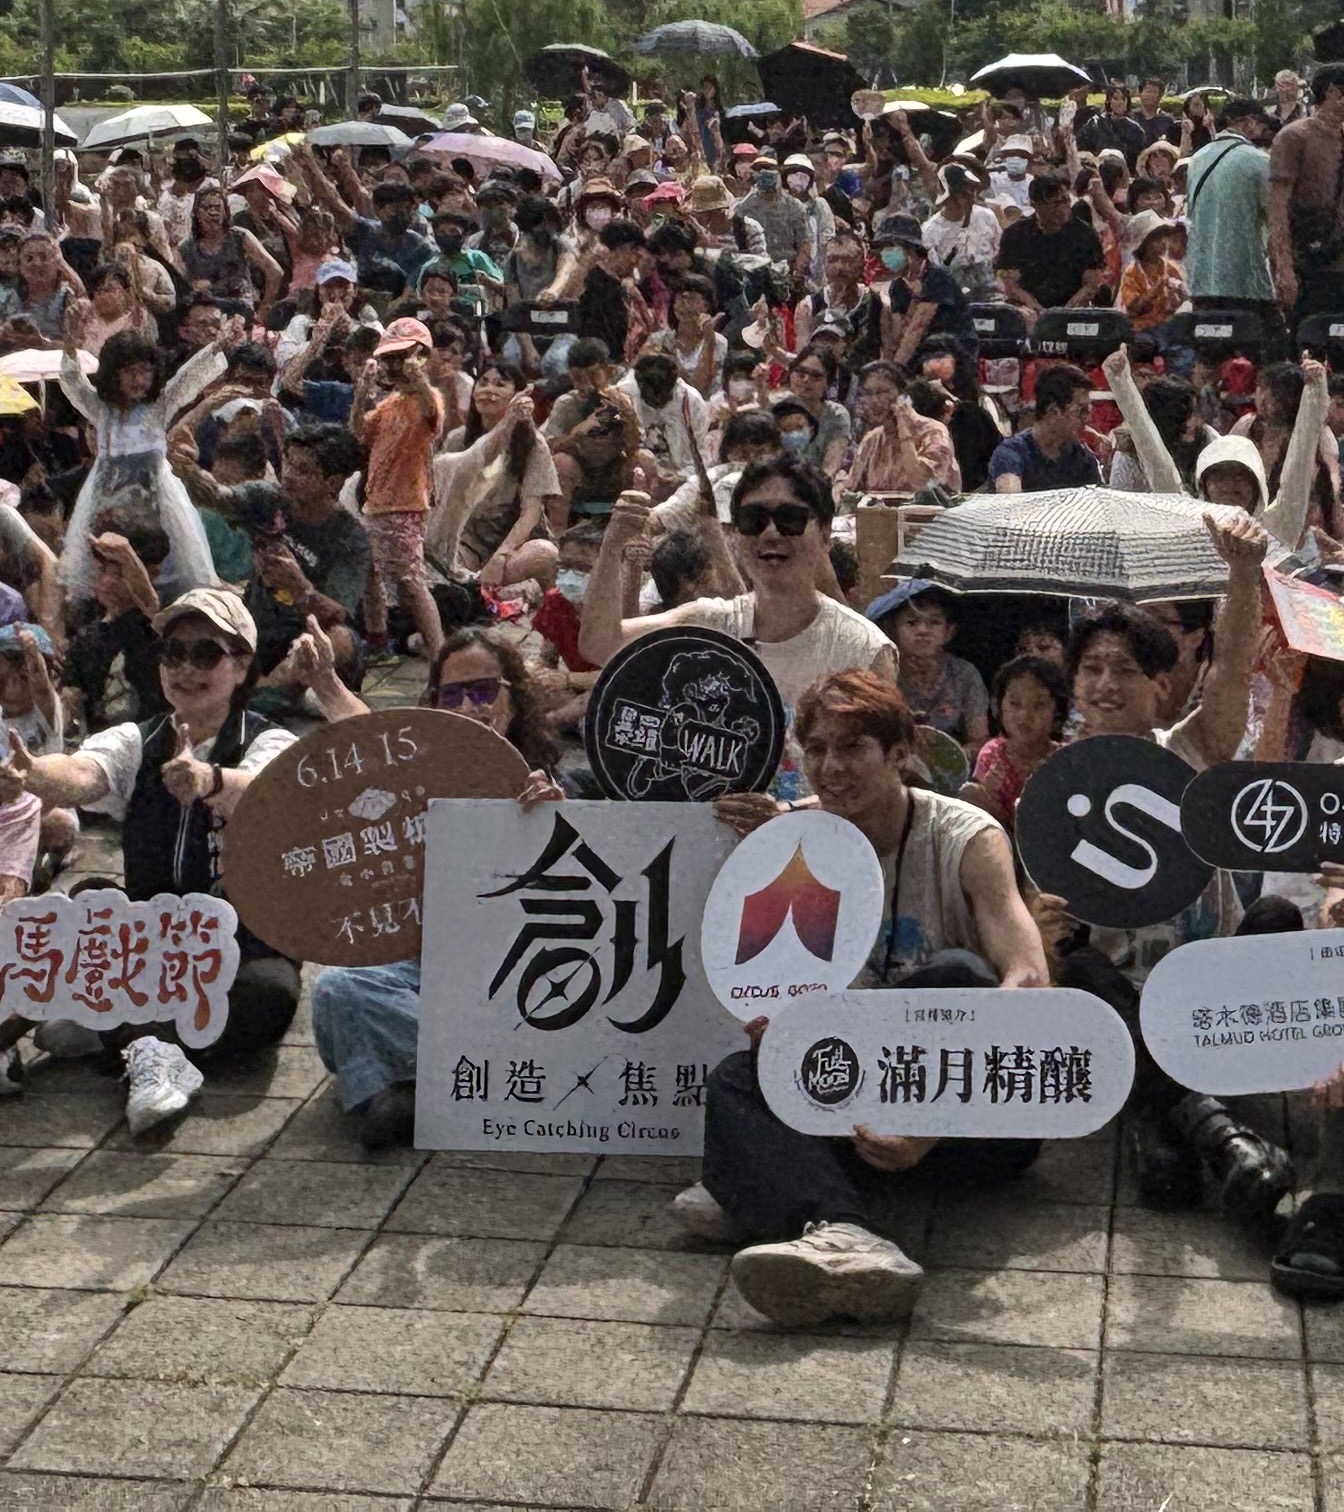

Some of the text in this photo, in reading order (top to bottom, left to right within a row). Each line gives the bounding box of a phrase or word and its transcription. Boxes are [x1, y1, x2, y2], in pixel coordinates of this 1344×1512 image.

[684, 730, 743, 774] WALK
[877, 1045, 1093, 1104] 滿月精釀
[483, 1118, 516, 1138] Eye
